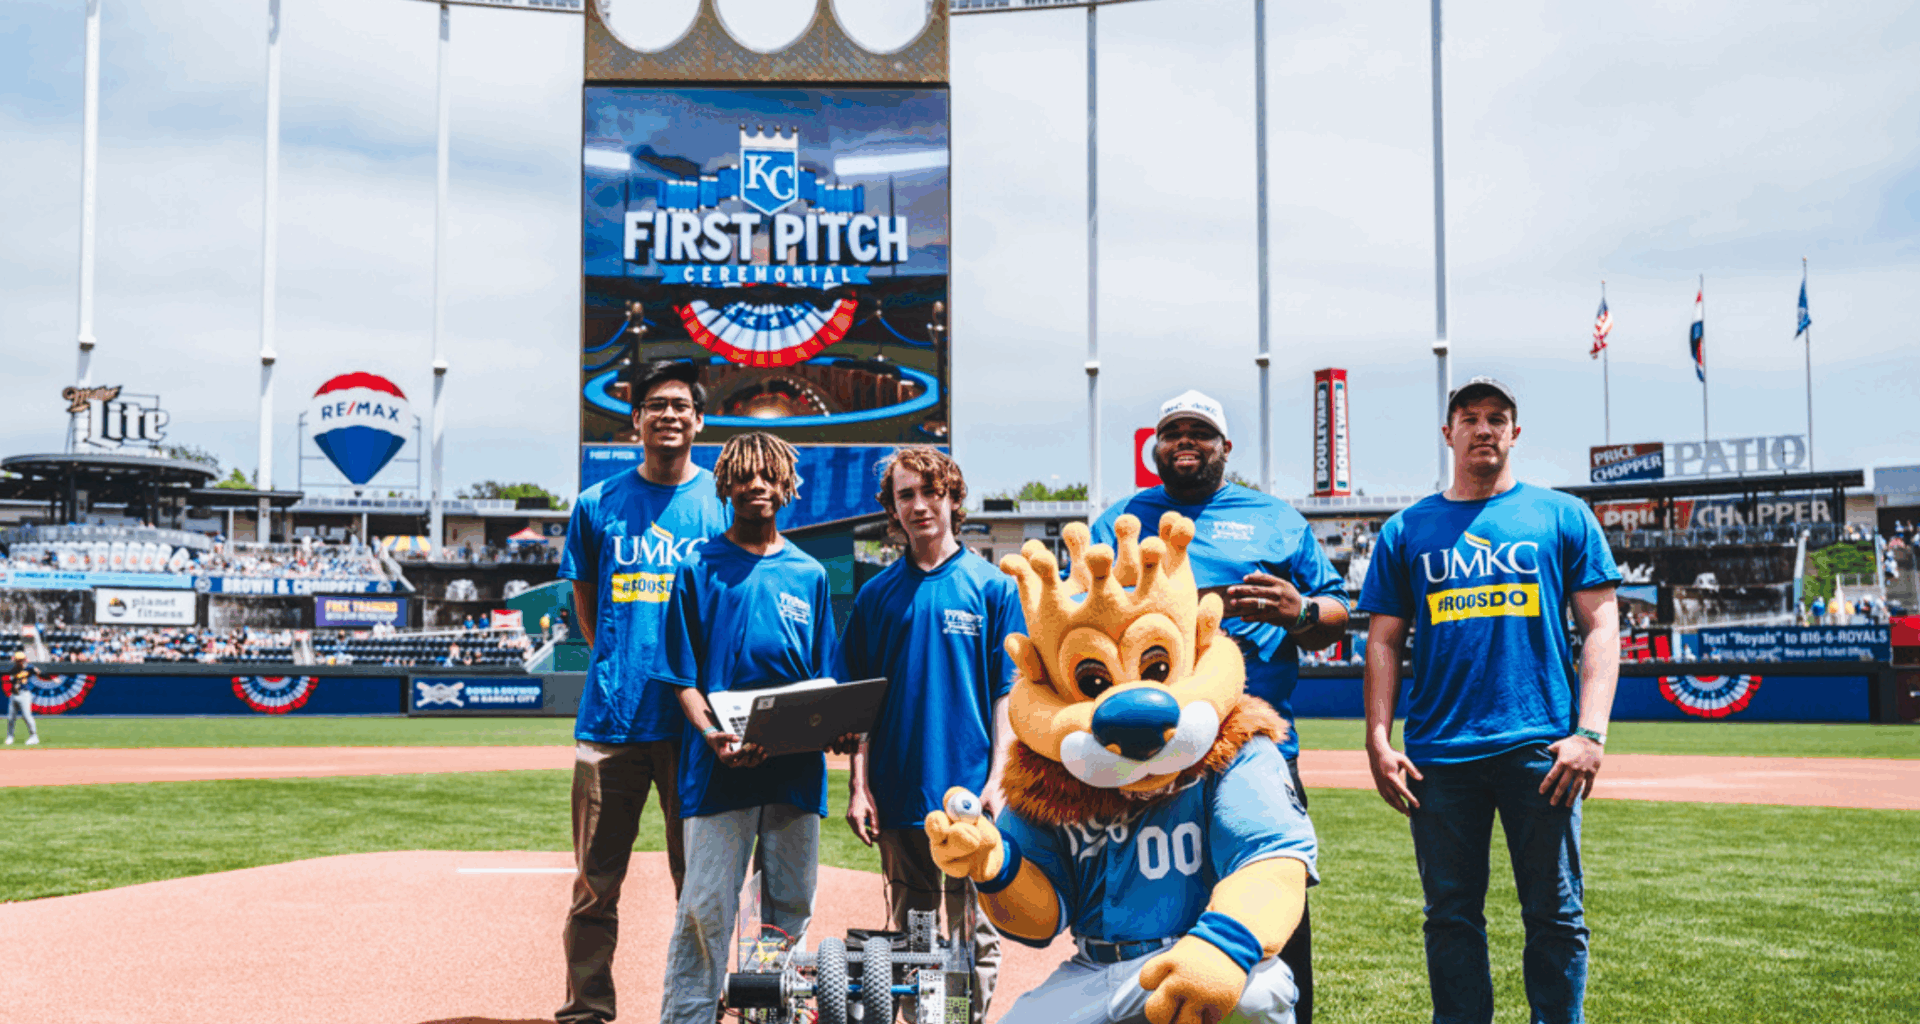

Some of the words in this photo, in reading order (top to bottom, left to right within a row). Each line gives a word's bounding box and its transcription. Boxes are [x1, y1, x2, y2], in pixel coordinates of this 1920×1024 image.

[745, 154, 795, 200] KC
[624, 212, 761, 261] FIRST
[775, 214, 908, 262] PITCH
[683, 267, 851, 283] CEREMONIAL
[84, 398, 170, 450] Lite
[321, 401, 399, 422] RE/MAX
[1316, 389, 1327, 481] BOULEVARD
[1594, 445, 1636, 466] PRICE
[1671, 436, 1806, 475] PATIO
[1593, 455, 1662, 482] CHOPPER
[1420, 540, 1539, 584] UMKC
[222, 578, 275, 594] BROWN
[277, 578, 290, 594] &
[132, 596, 176, 609] planet
[138, 608, 184, 619] fitness
[1437, 589, 1528, 613] #ROOSDO
[1702, 632, 1727, 645] Text
[1784, 631, 1798, 644] to
[1137, 822, 1203, 880] 00
